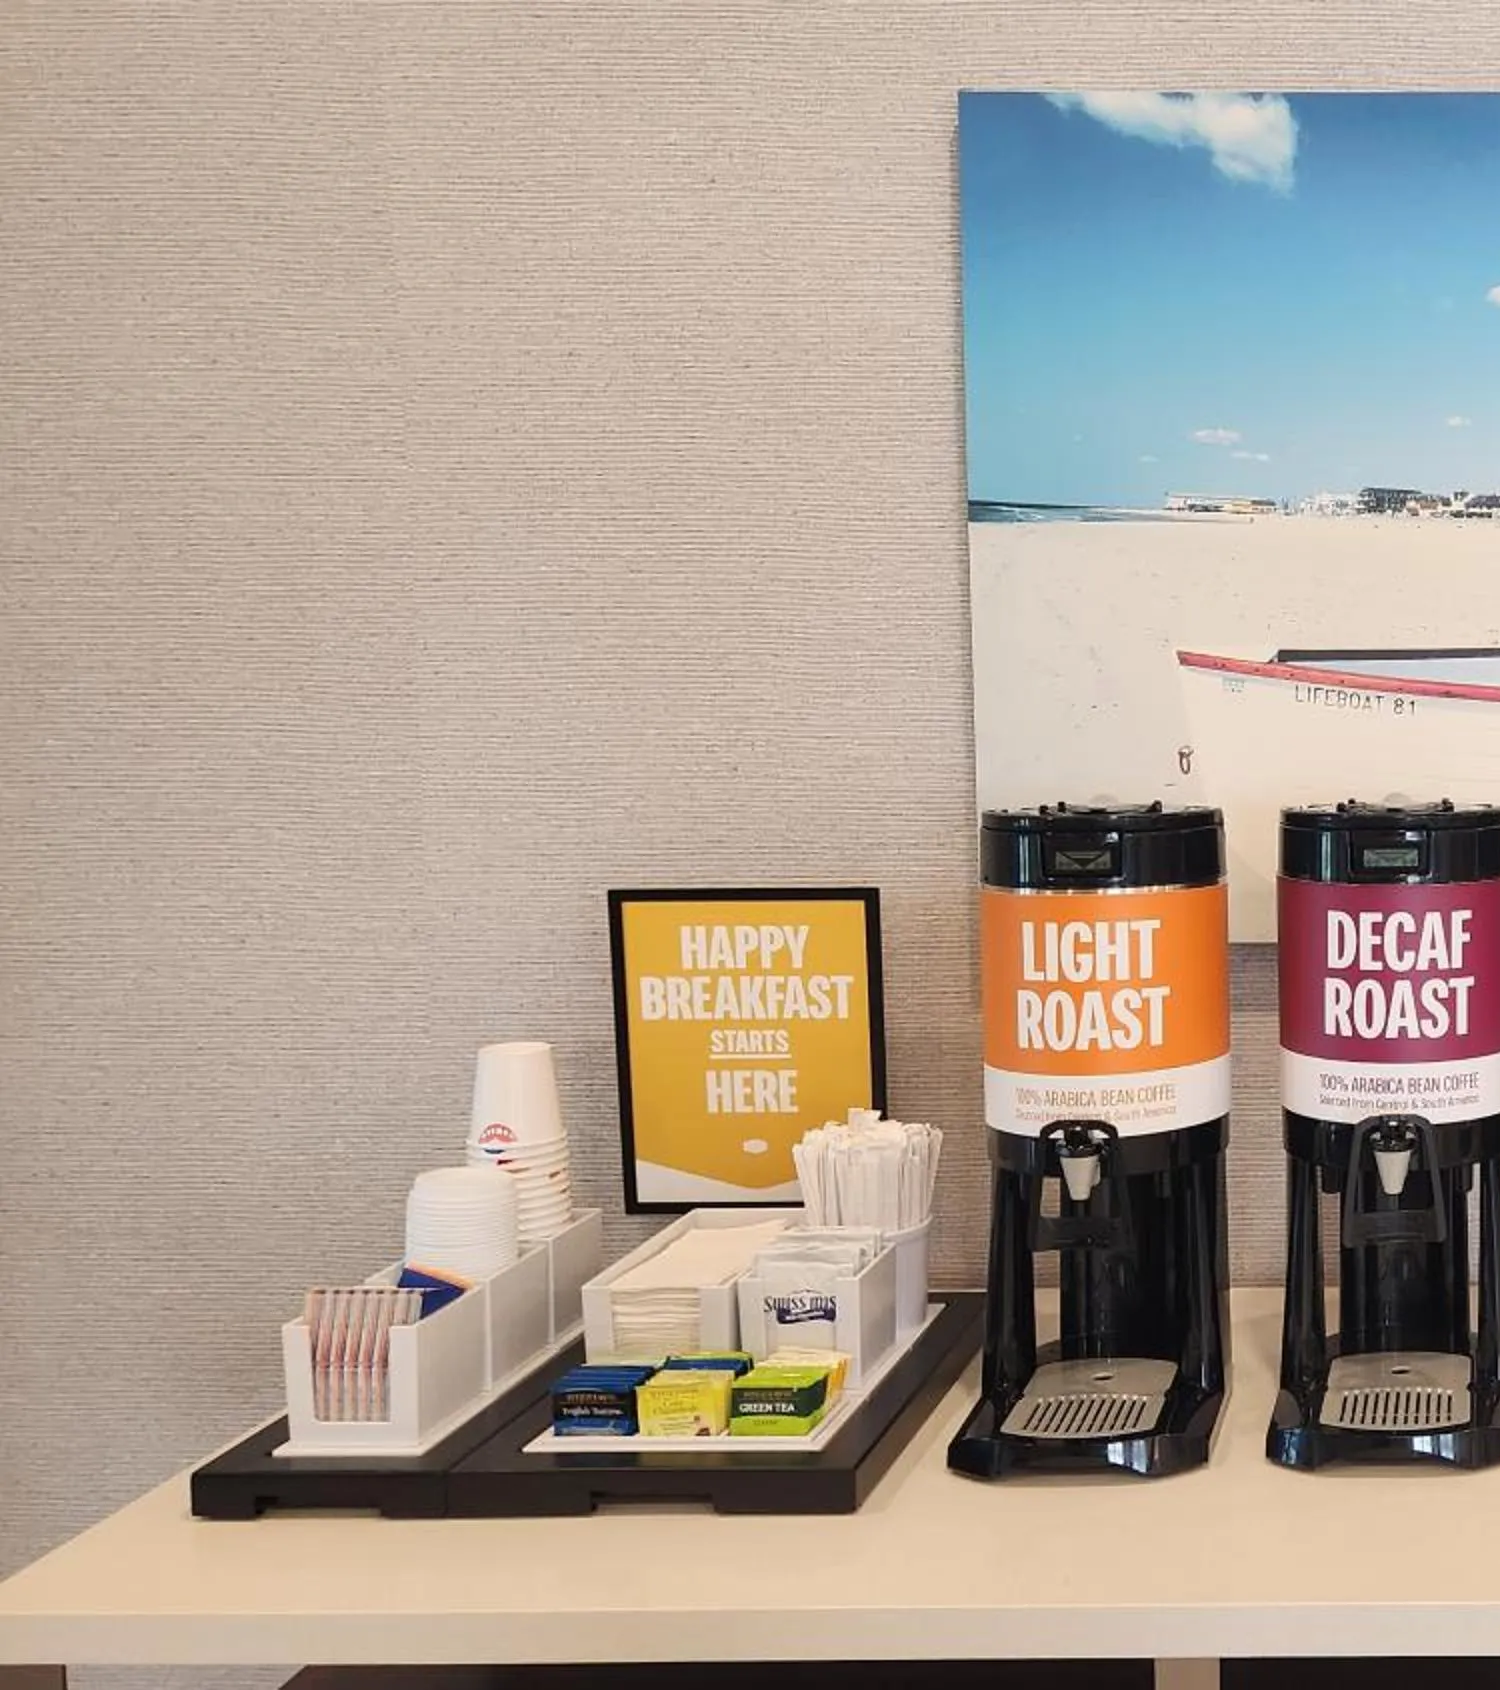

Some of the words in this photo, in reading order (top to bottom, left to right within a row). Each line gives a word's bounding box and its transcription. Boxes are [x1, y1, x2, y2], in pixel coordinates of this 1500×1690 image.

[1294, 685, 1385, 713] LIFEBOAT
[1393, 698, 1417, 716] 81
[680, 925, 809, 970] HAPPY
[1021, 919, 1161, 983] LIGHT
[1326, 909, 1473, 971] DECAF
[639, 975, 855, 1021] BREAKFAST
[1016, 985, 1171, 1053] ROAST
[1323, 975, 1475, 1040] ROAST
[710, 1029, 790, 1054] STARTS
[705, 1069, 800, 1114] HERE
[1044, 1088, 1096, 1107] ARABICA
[1101, 1088, 1134, 1107] BEAN
[1319, 1073, 1349, 1091] 100%
[1351, 1076, 1405, 1095] ARABICA
[1407, 1076, 1441, 1095] BEAN
[1443, 1071, 1479, 1090] COFFEE
[739, 1402, 773, 1413] GREEN
[775, 1402, 796, 1413] TEA
